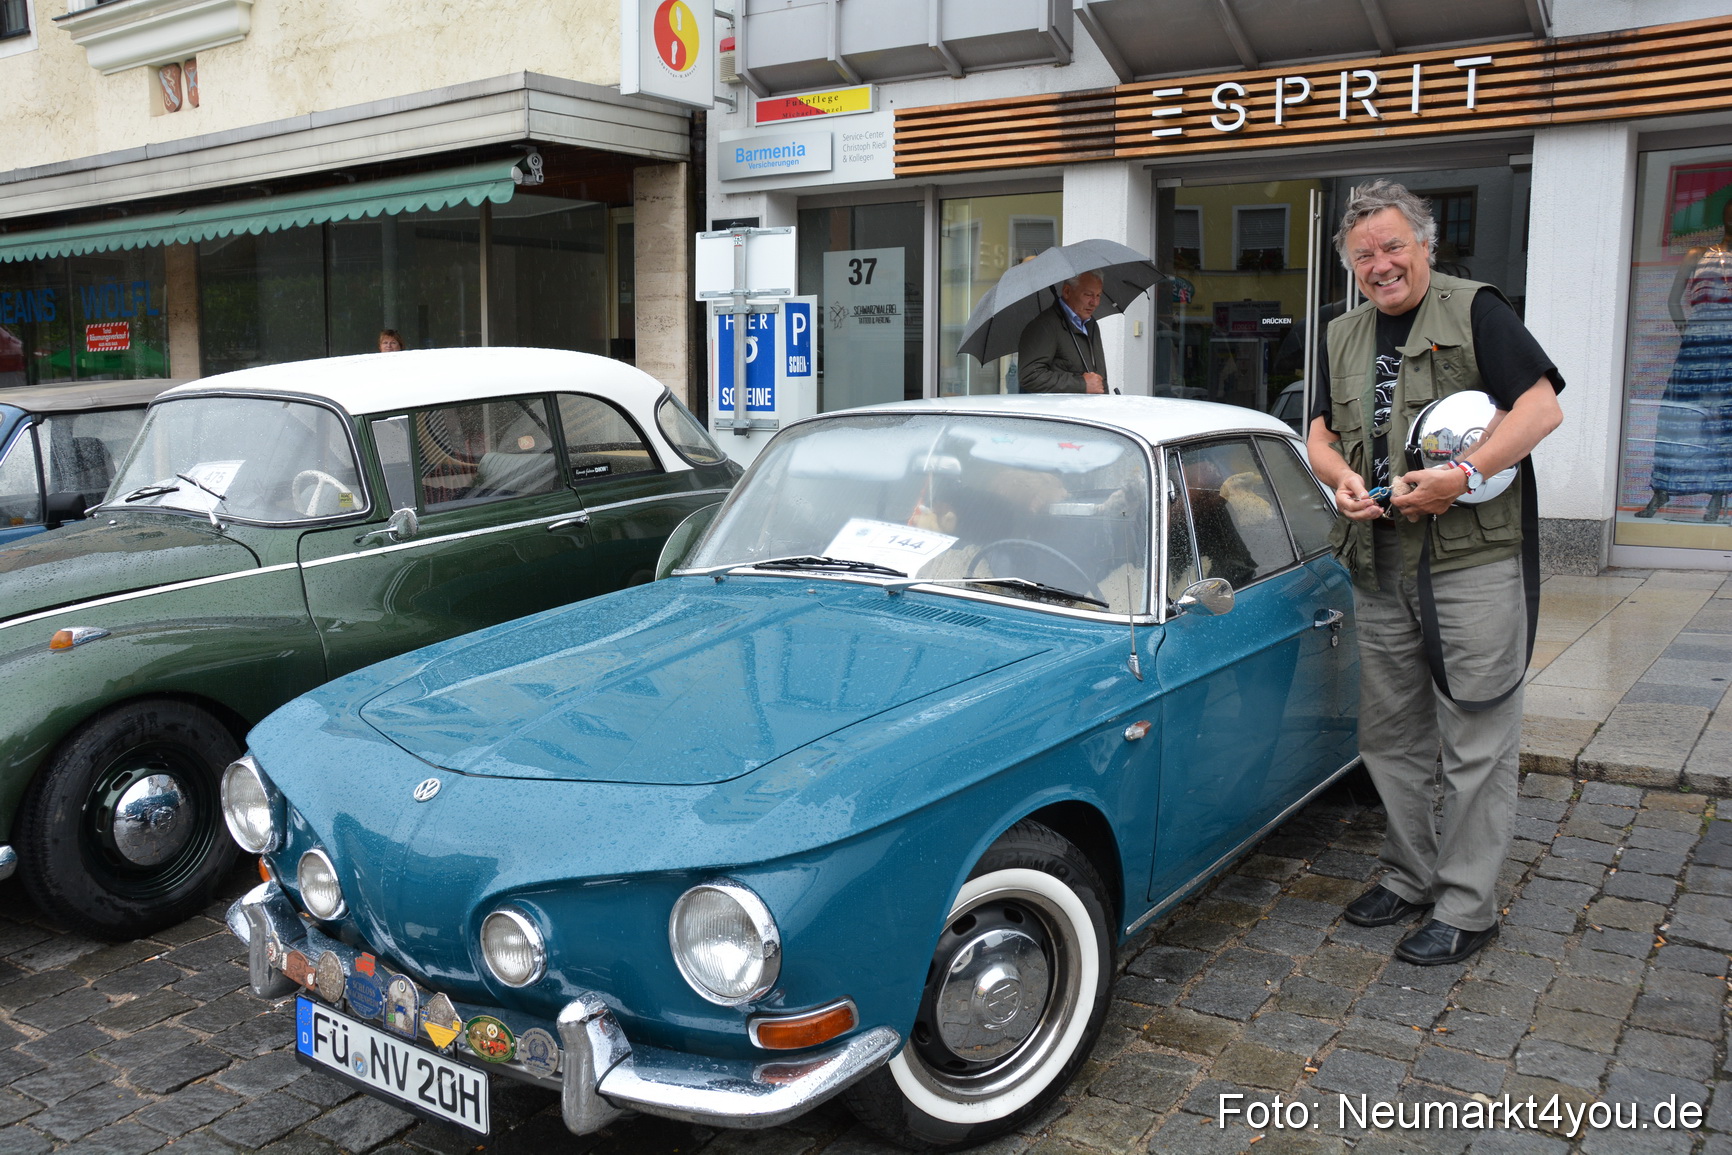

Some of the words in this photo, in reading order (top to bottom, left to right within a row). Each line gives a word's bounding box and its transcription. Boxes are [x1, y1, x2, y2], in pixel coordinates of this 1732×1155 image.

[785, 94, 840, 108] Fußpflege
[1152, 56, 1494, 132] ESPRIT
[782, 108, 814, 118] Michael
[842, 130, 885, 142] Service-Center
[735, 142, 806, 164] Barmenia
[842, 142, 871, 154] Christoph
[872, 140, 888, 150] Riedl
[748, 158, 800, 170] Versicherungen
[842, 155, 848, 163] &
[849, 153, 874, 165] Kollegen
[848, 258, 877, 285] 37
[80, 276, 159, 320] WÖLFL
[1262, 317, 1292, 325] DRÜCKEN
[792, 312, 807, 346] P
[887, 534, 925, 550] 144
[302, 1032, 309, 1045] D
[313, 1011, 350, 1068] FÜ
[370, 1036, 410, 1092] NV
[416, 1057, 481, 1125] 20H
